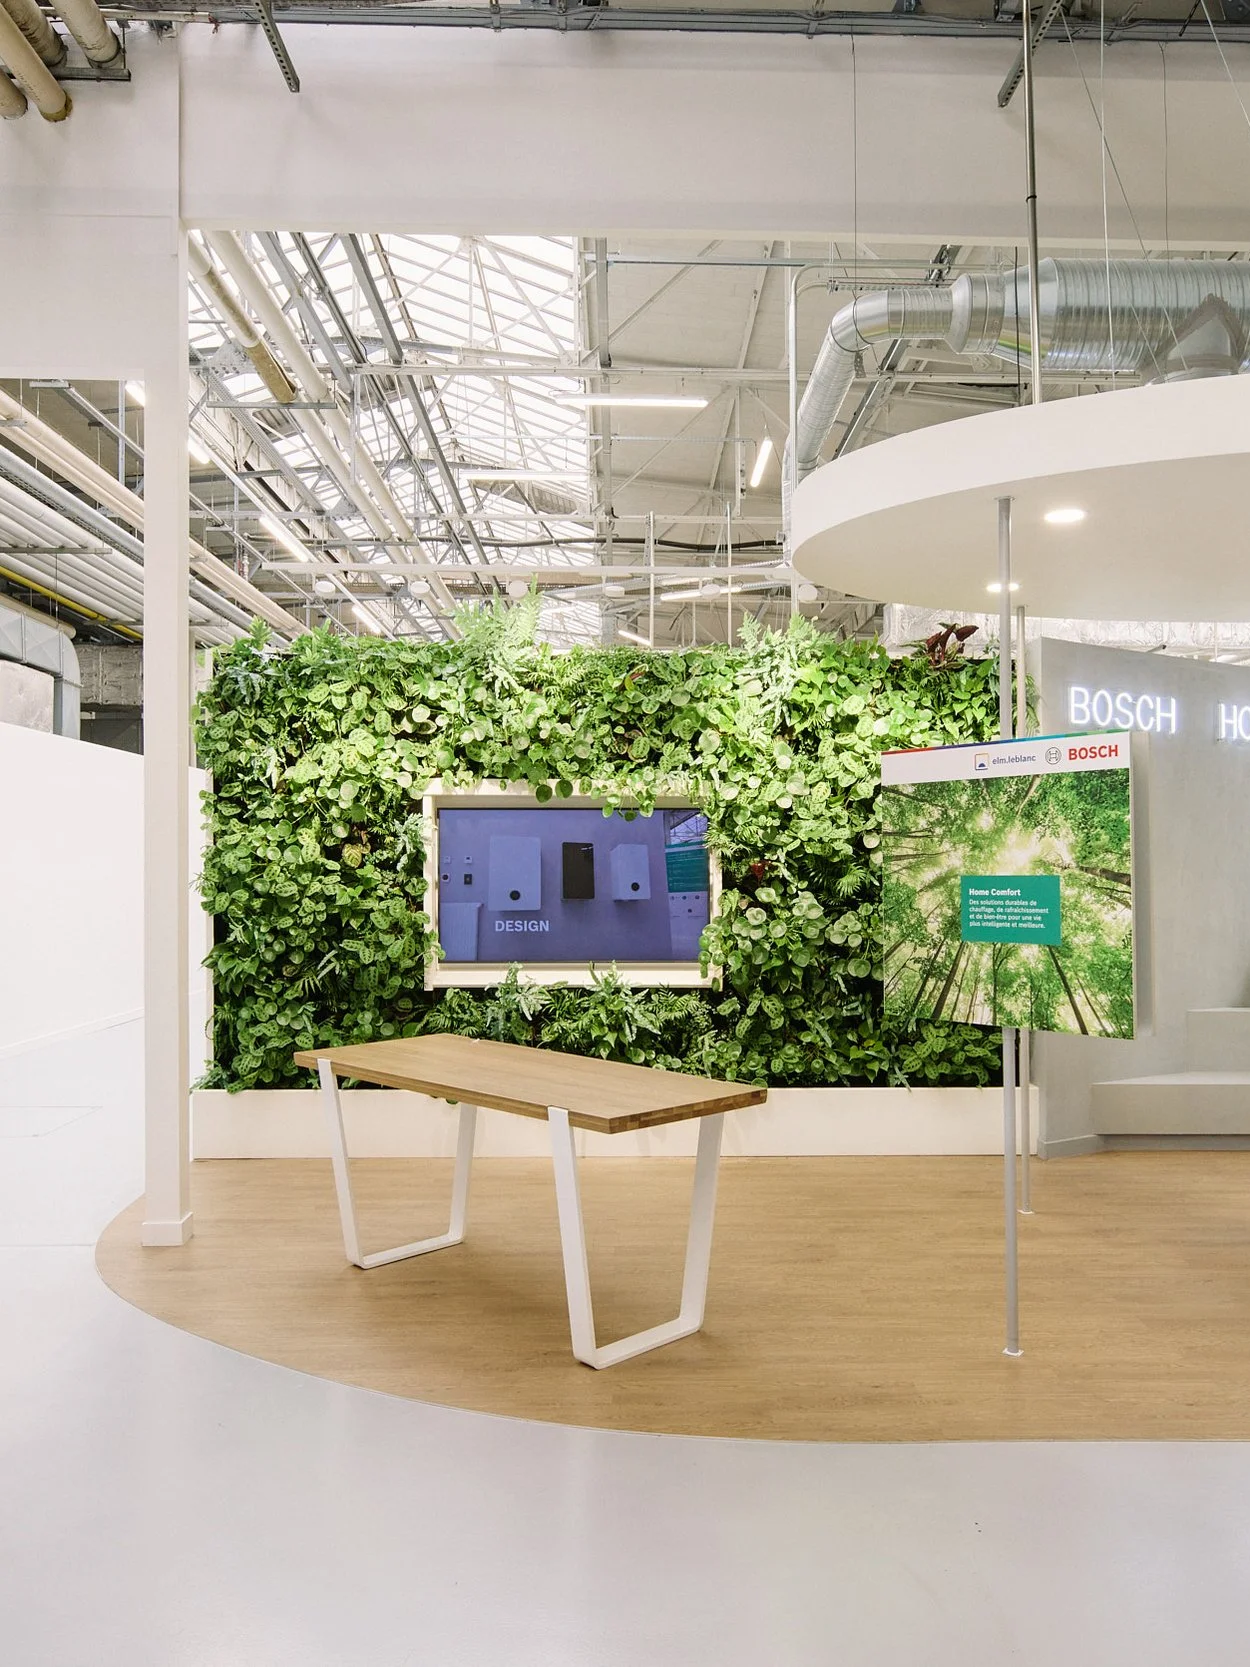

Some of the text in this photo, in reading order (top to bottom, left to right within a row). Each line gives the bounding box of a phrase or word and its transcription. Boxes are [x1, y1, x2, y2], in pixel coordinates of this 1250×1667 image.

[1069, 686, 1177, 734] BOSCH
[992, 744, 1118, 765] elm.leblanc BOSCH
[969, 888, 1021, 896] Home Comfort
[495, 919, 550, 932] DESIGN
[982, 921, 1010, 929] intelligente
